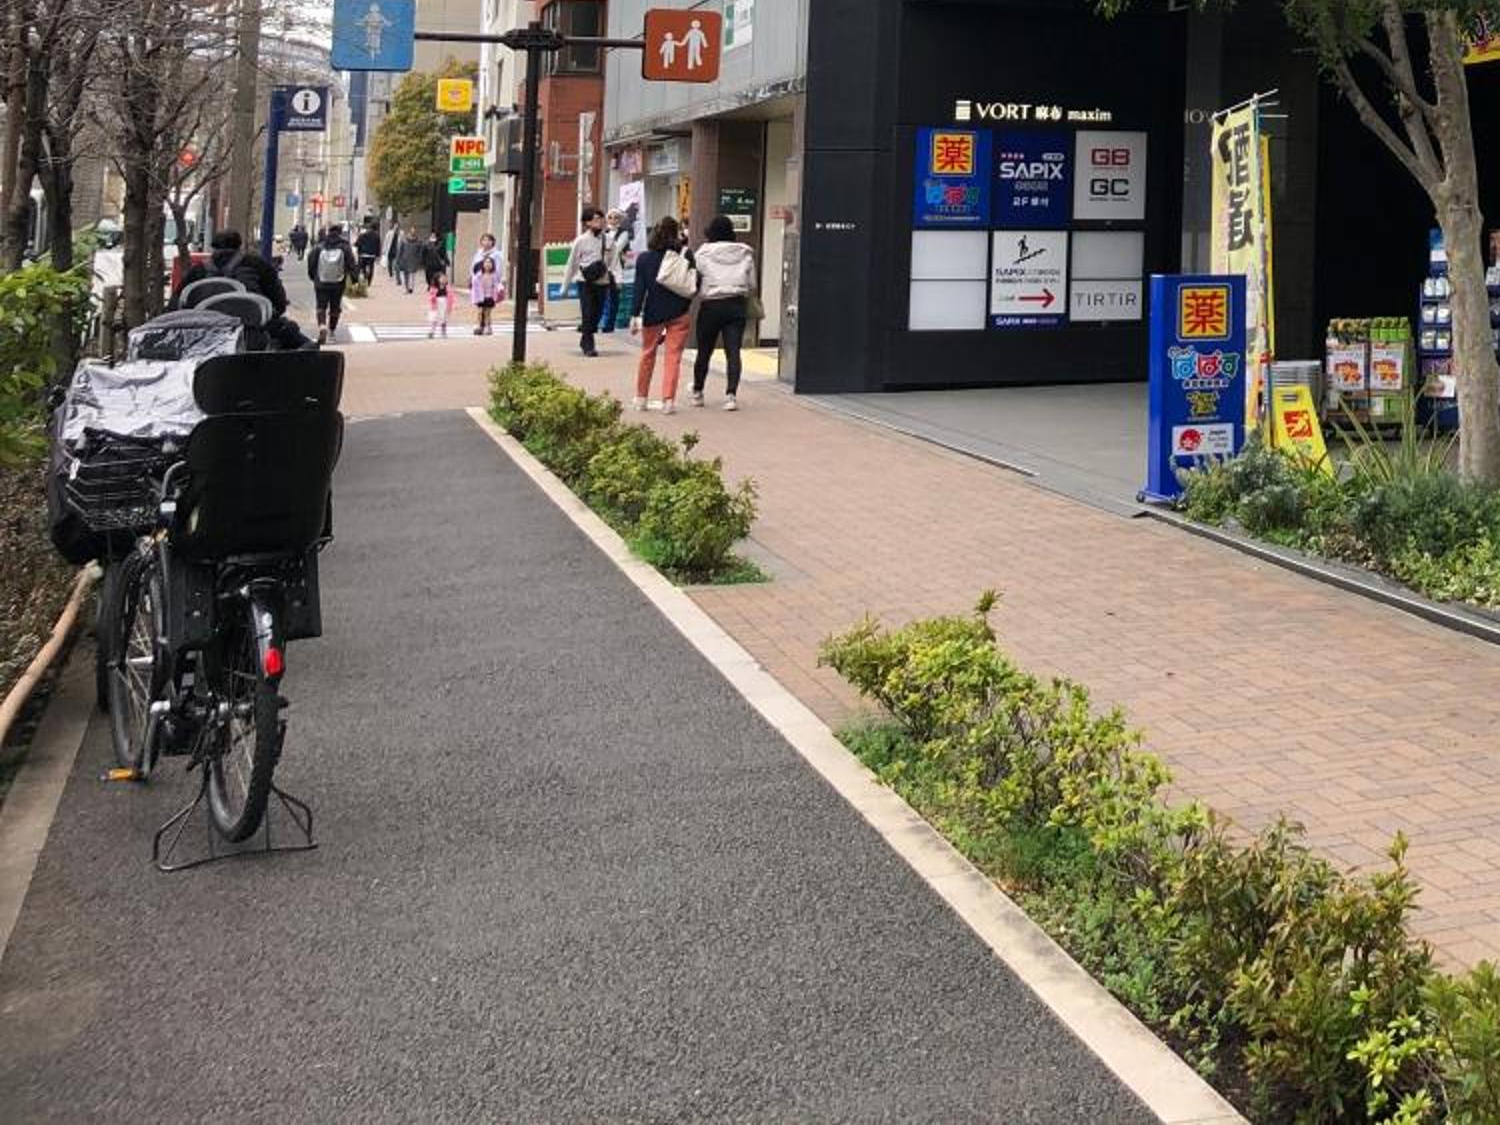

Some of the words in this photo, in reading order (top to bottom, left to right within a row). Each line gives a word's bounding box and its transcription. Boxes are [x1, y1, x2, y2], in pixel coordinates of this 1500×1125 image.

[976, 103, 1032, 120] VORT
[1067, 108, 1112, 121] maxim
[455, 139, 486, 155] NPC
[936, 136, 971, 171] 薬
[1091, 148, 1131, 166] GB
[1000, 162, 1064, 180] SAPIX
[1090, 179, 1130, 196] GC
[1075, 292, 1137, 307] TIRTIR
[1184, 290, 1225, 334] 薬
